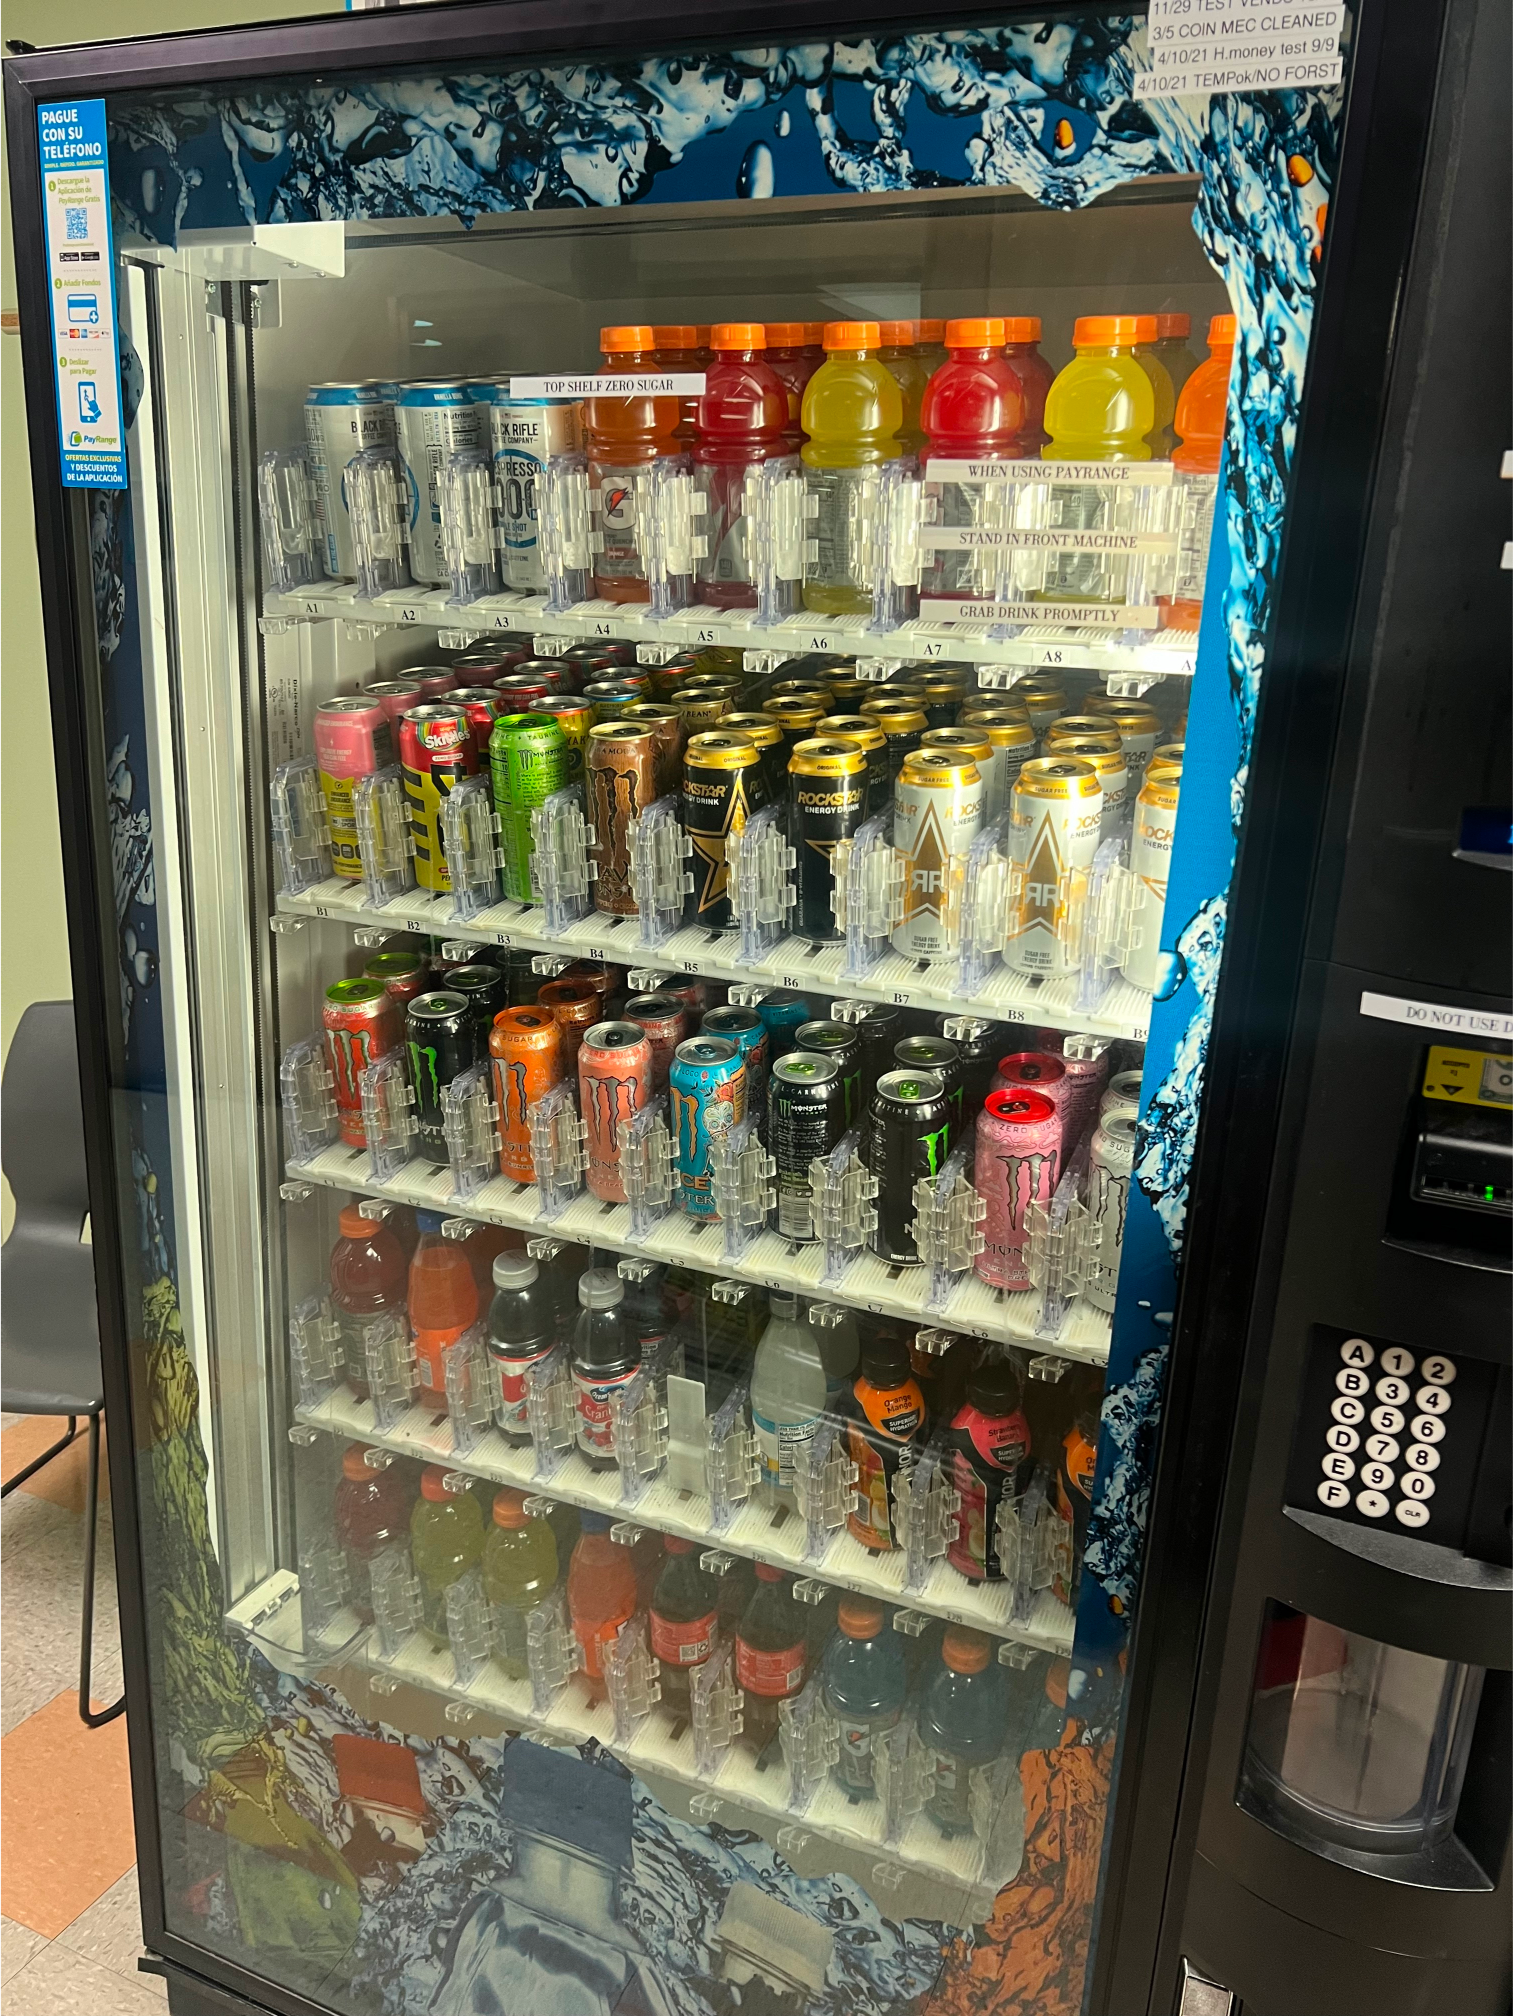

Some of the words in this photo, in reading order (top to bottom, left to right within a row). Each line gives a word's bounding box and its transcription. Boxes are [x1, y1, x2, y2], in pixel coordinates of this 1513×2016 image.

[1154, 0, 1191, 16] 11/29
[1198, 0, 1233, 12] TEST
[1153, 26, 1174, 40] 3/5
[1179, 22, 1216, 38] COIN
[1221, 18, 1256, 34] MEC
[1261, 12, 1337, 31] CLEANED
[1158, 48, 1207, 65] 4/10/21
[1214, 43, 1276, 62] H.money
[1281, 41, 1306, 54] test
[1311, 37, 1334, 52] 9/9
[1138, 76, 1187, 92] 4/10/21
[1285, 63, 1340, 80] FORST
[42, 109, 78, 124] PAGUE
[43, 128, 65, 142] CON
[68, 126, 83, 140] SU
[44, 142, 102, 159] TELÉFONO
[544, 382, 566, 393] TOP
[568, 381, 602, 392] SHELF
[606, 380, 634, 392] ZERO
[637, 379, 674, 390] SUGAR
[512, 424, 538, 436] RIFLE
[84, 435, 118, 445] PayRange
[90, 454, 122, 462] EXCLUSIVAS
[76, 464, 118, 472] DESCUENTOS
[968, 465, 1008, 478] WHEN
[1012, 466, 1052, 478] USING
[1055, 466, 1130, 480] PAYRANGE
[86, 474, 122, 483] APLICACIÓN
[512, 522, 527, 532] SHOT
[960, 532, 1002, 544] STAND
[1006, 534, 1019, 545] IN
[1024, 534, 1070, 548] FRONT
[1073, 535, 1138, 549] MACHINE
[306, 603, 318, 614] A1
[960, 606, 995, 619] GRAB
[998, 606, 1041, 620] DRINK
[1044, 608, 1120, 622] PROMPTLY
[401, 610, 416, 621] A2
[494, 616, 510, 628] A3
[594, 624, 610, 635] A4
[698, 630, 714, 642] A5
[810, 638, 828, 650] A6
[924, 644, 942, 656] A7
[1042, 651, 1062, 664] A8
[425, 730, 470, 748] Skittles
[528, 730, 559, 740] TAURINE
[683, 783, 726, 798] CKSTAR
[697, 796, 720, 806] DRINK
[798, 788, 864, 806] ROCKSTAR
[805, 805, 838, 814] ENERGY
[838, 803, 860, 814] DRINK
[317, 907, 328, 918] B1
[407, 920, 420, 932] B2
[496, 934, 511, 944] B3
[590, 948, 604, 960] B4
[684, 962, 699, 972] B5
[784, 976, 800, 988] B6
[894, 993, 910, 1005] B7
[342, 1004, 374, 1014] SUGAR
[1008, 1010, 1025, 1022] B8
[1406, 1006, 1427, 1020] DO
[1431, 1011, 1466, 1026] NOT
[1470, 1016, 1500, 1032] USE
[1000, 1124, 1028, 1134] ZERO
[1034, 1117, 1058, 1134] SUGAR
[1348, 1346, 1365, 1363] A
[1392, 1354, 1402, 1370] 1
[1431, 1362, 1444, 1380] 2
[1346, 1374, 1360, 1390] B
[1386, 1384, 1398, 1400] 3
[1426, 1392, 1440, 1408] 4
[884, 1394, 912, 1407] Orange
[887, 1402, 912, 1414] Mango
[1340, 1402, 1357, 1419] C
[1380, 1412, 1394, 1428] 5
[1420, 1421, 1434, 1437] 6
[1336, 1430, 1352, 1447] D
[1377, 1440, 1390, 1456] 7
[1416, 1450, 1428, 1466] 8
[1332, 1458, 1346, 1476] E
[1372, 1468, 1384, 1484] 9
[1412, 1478, 1424, 1494] 0
[1327, 1486, 1342, 1500] F
[1404, 1509, 1420, 1518] CLR
